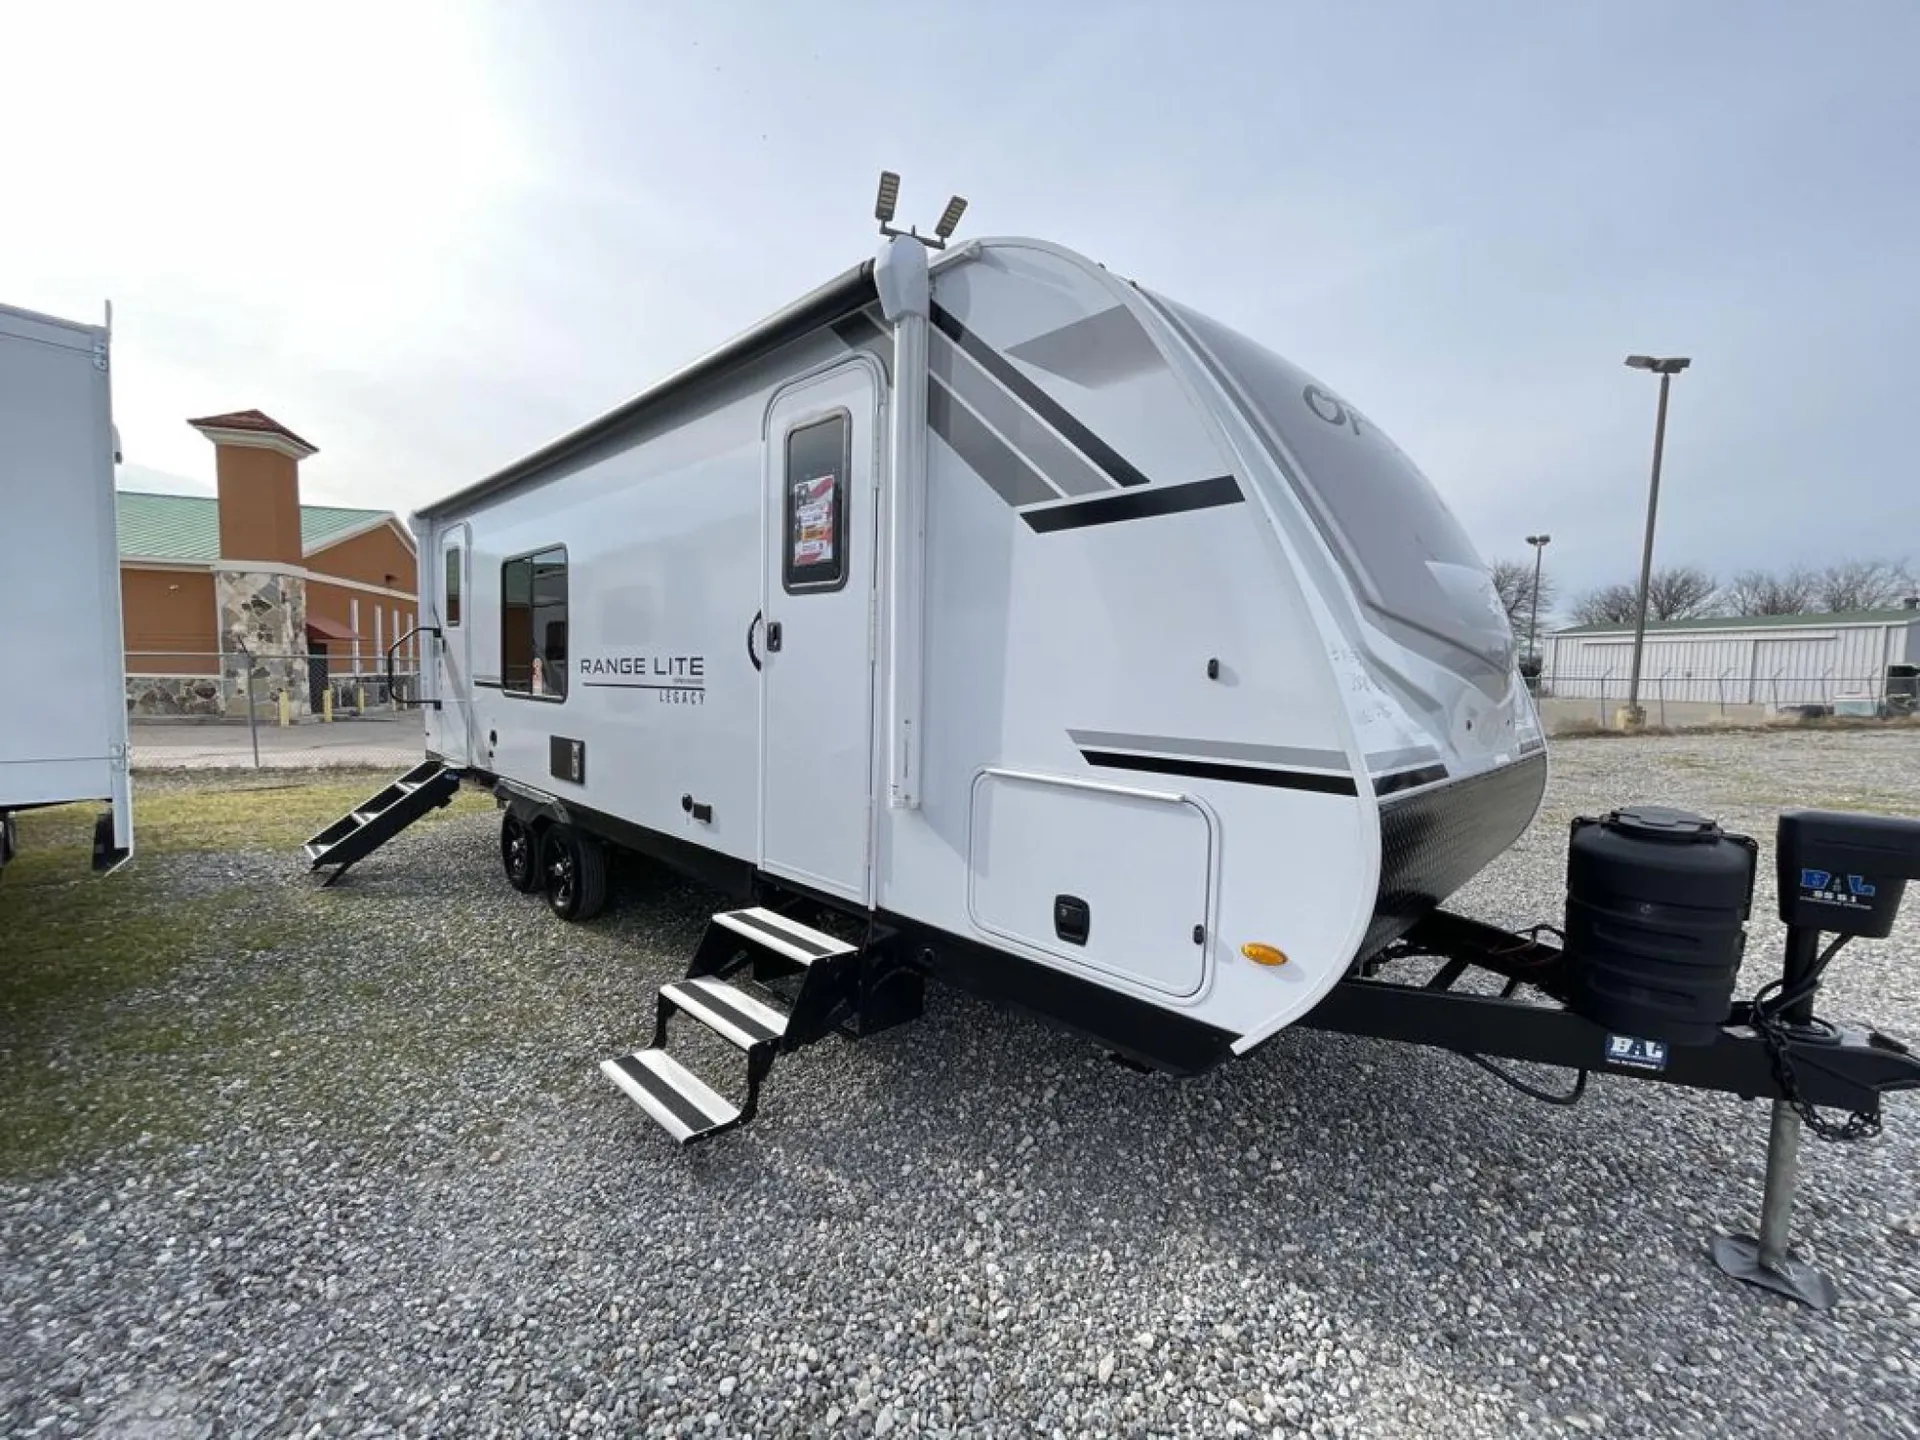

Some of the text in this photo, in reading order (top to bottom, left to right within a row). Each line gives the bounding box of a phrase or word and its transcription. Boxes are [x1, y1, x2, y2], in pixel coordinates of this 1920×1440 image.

[580, 657, 704, 676] RANGE LITE
[659, 689, 705, 706] LEGACY
